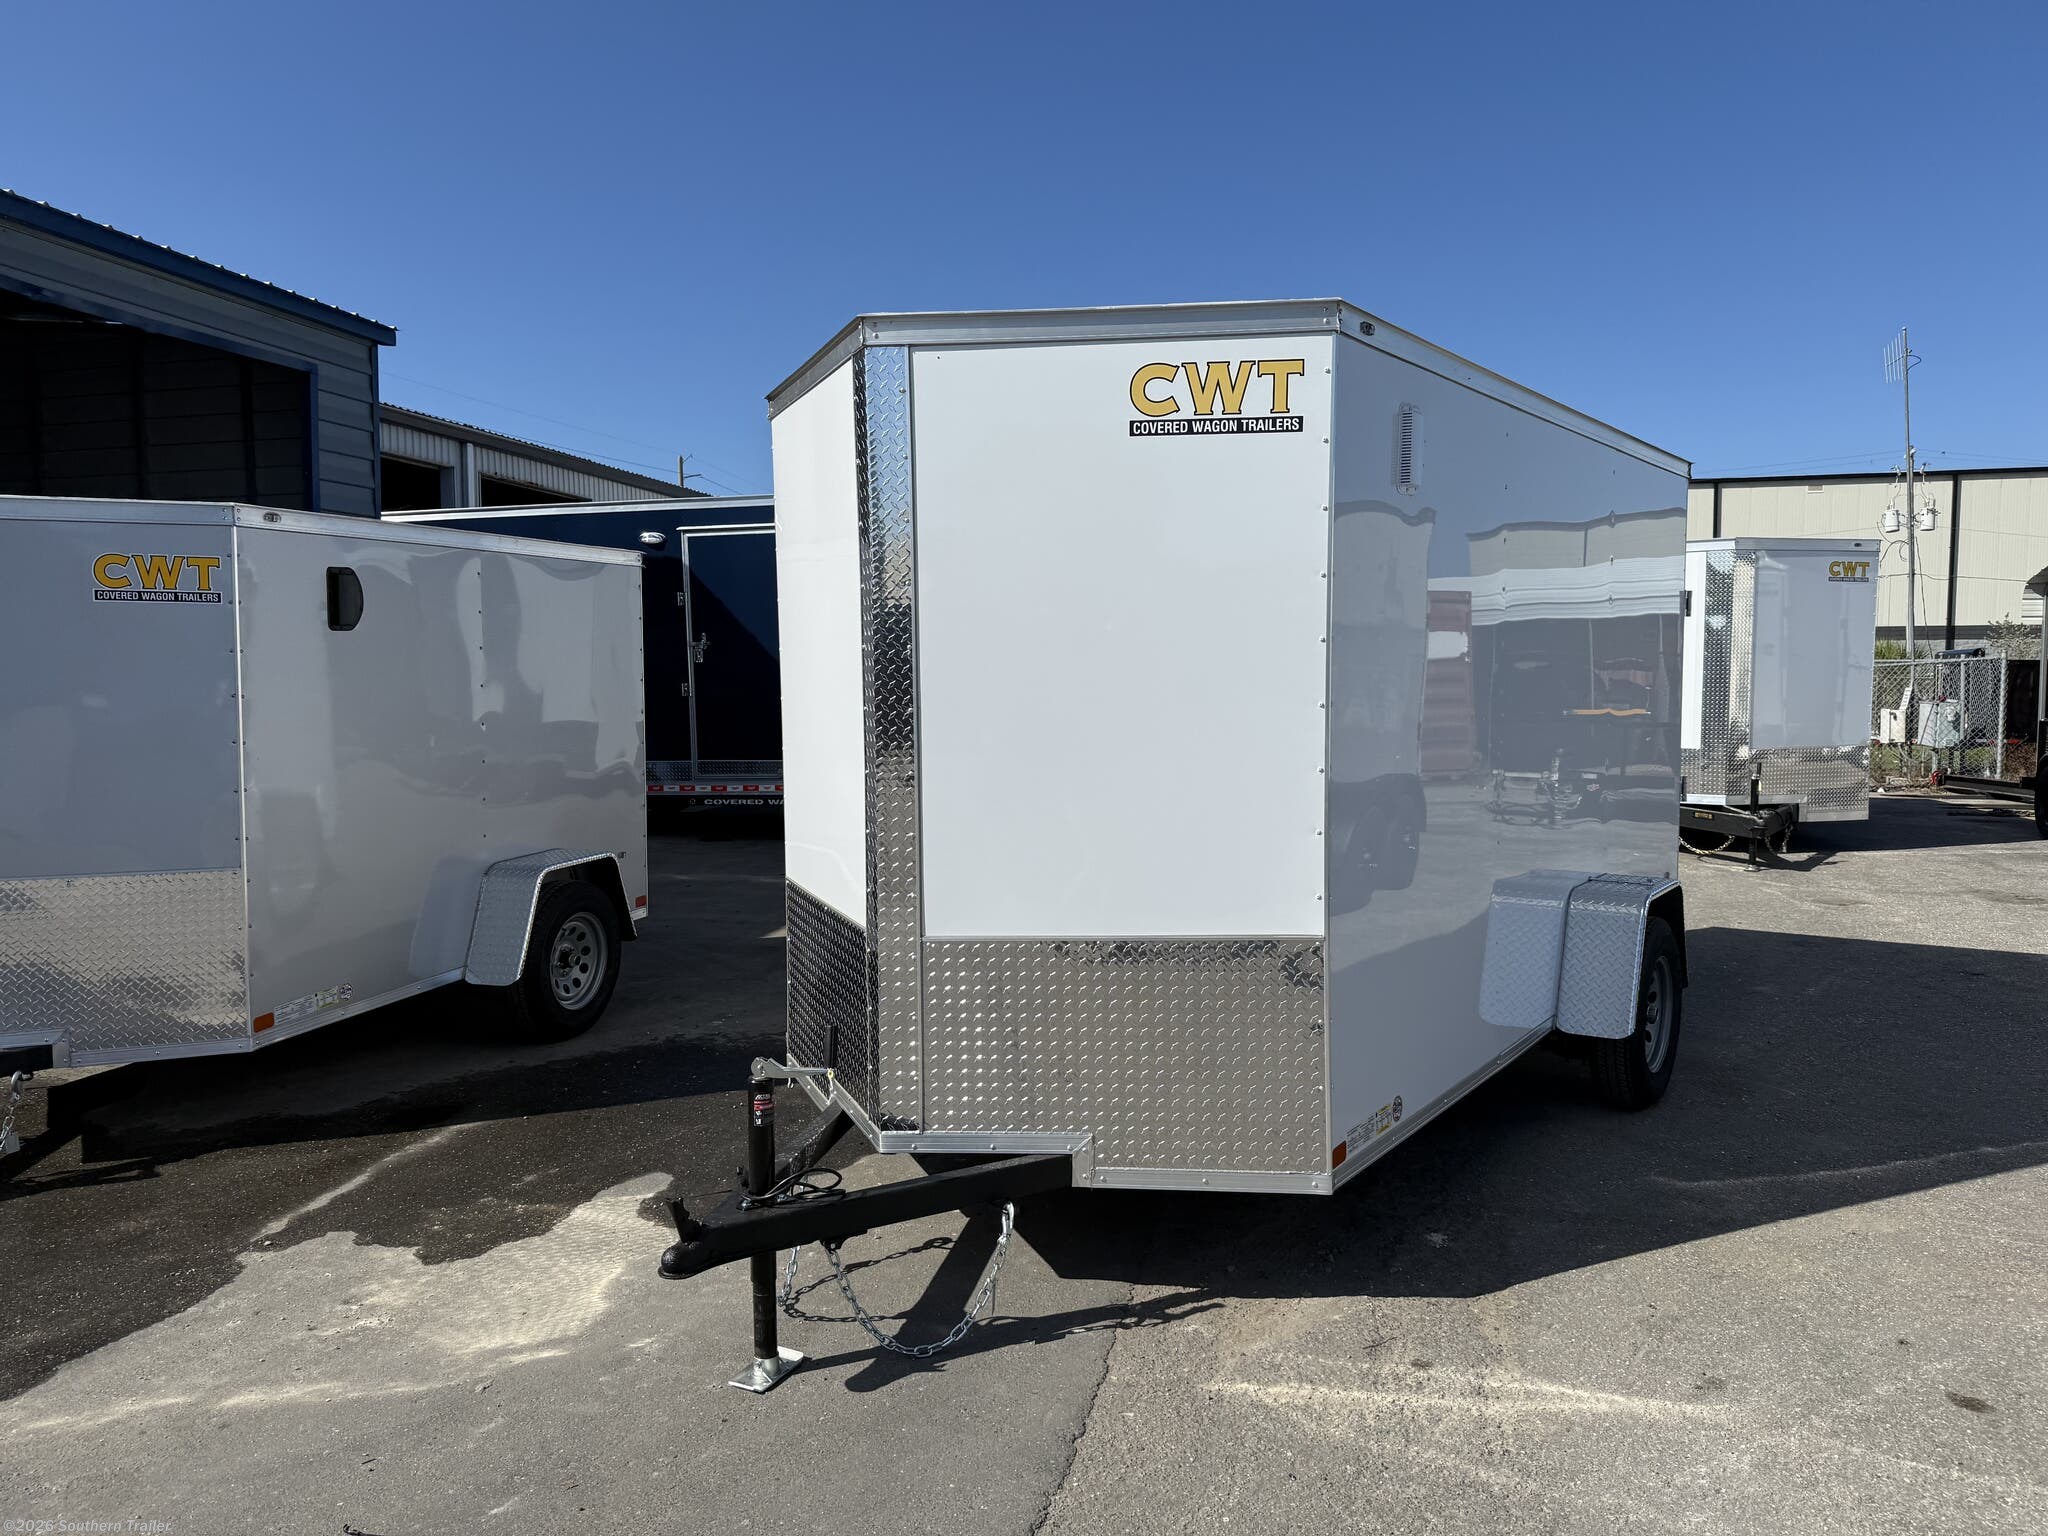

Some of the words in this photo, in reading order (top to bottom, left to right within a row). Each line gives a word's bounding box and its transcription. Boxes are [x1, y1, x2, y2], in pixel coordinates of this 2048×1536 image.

[1130, 359, 1305, 417] CWT
[1133, 422, 1188, 435] COVERED
[1192, 419, 1237, 433] WAGON
[1241, 417, 1300, 432] TRAILERS
[93, 553, 221, 591] CWT
[1828, 560, 1870, 577] CWT
[97, 590, 139, 600] COVERED
[140, 591, 175, 601] WAGON
[177, 592, 219, 602] TRAILERS
